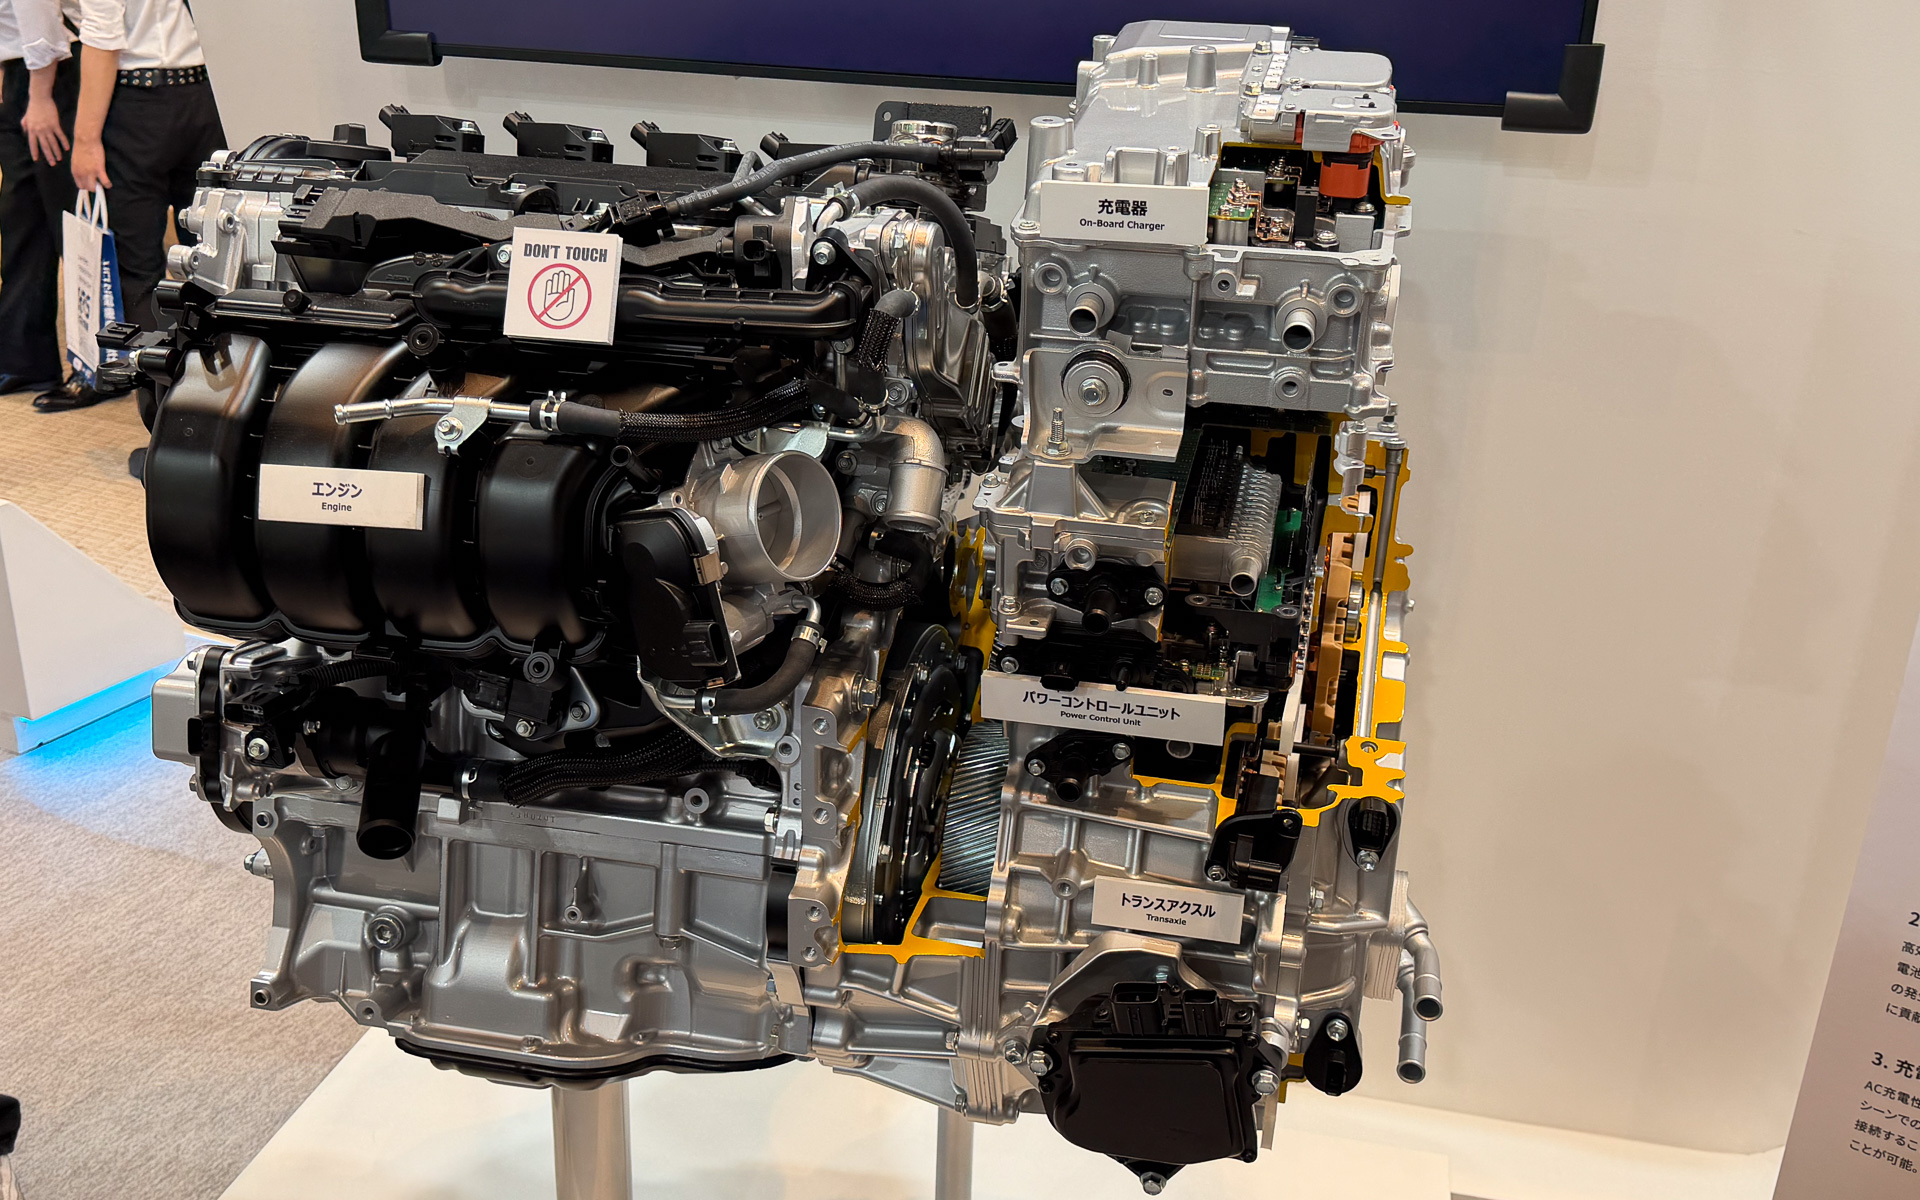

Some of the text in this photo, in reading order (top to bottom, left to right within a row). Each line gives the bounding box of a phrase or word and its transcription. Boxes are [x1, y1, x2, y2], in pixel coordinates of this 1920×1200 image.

[1098, 199, 1148, 216] 充電器
[1079, 218, 1165, 231] On-Board Charger
[523, 243, 608, 262] DON'T TOUCH
[312, 482, 363, 499] エンジン
[321, 502, 352, 512] Engine
[1022, 691, 1181, 720] パワーコントロールユニット
[1060, 711, 1141, 726] Power Control Unit
[1121, 893, 1216, 918] トランスアクスル
[1146, 914, 1187, 926] Transaxle
[1891, 983, 1920, 1001] の発
[1894, 1059, 1920, 1079] 充
